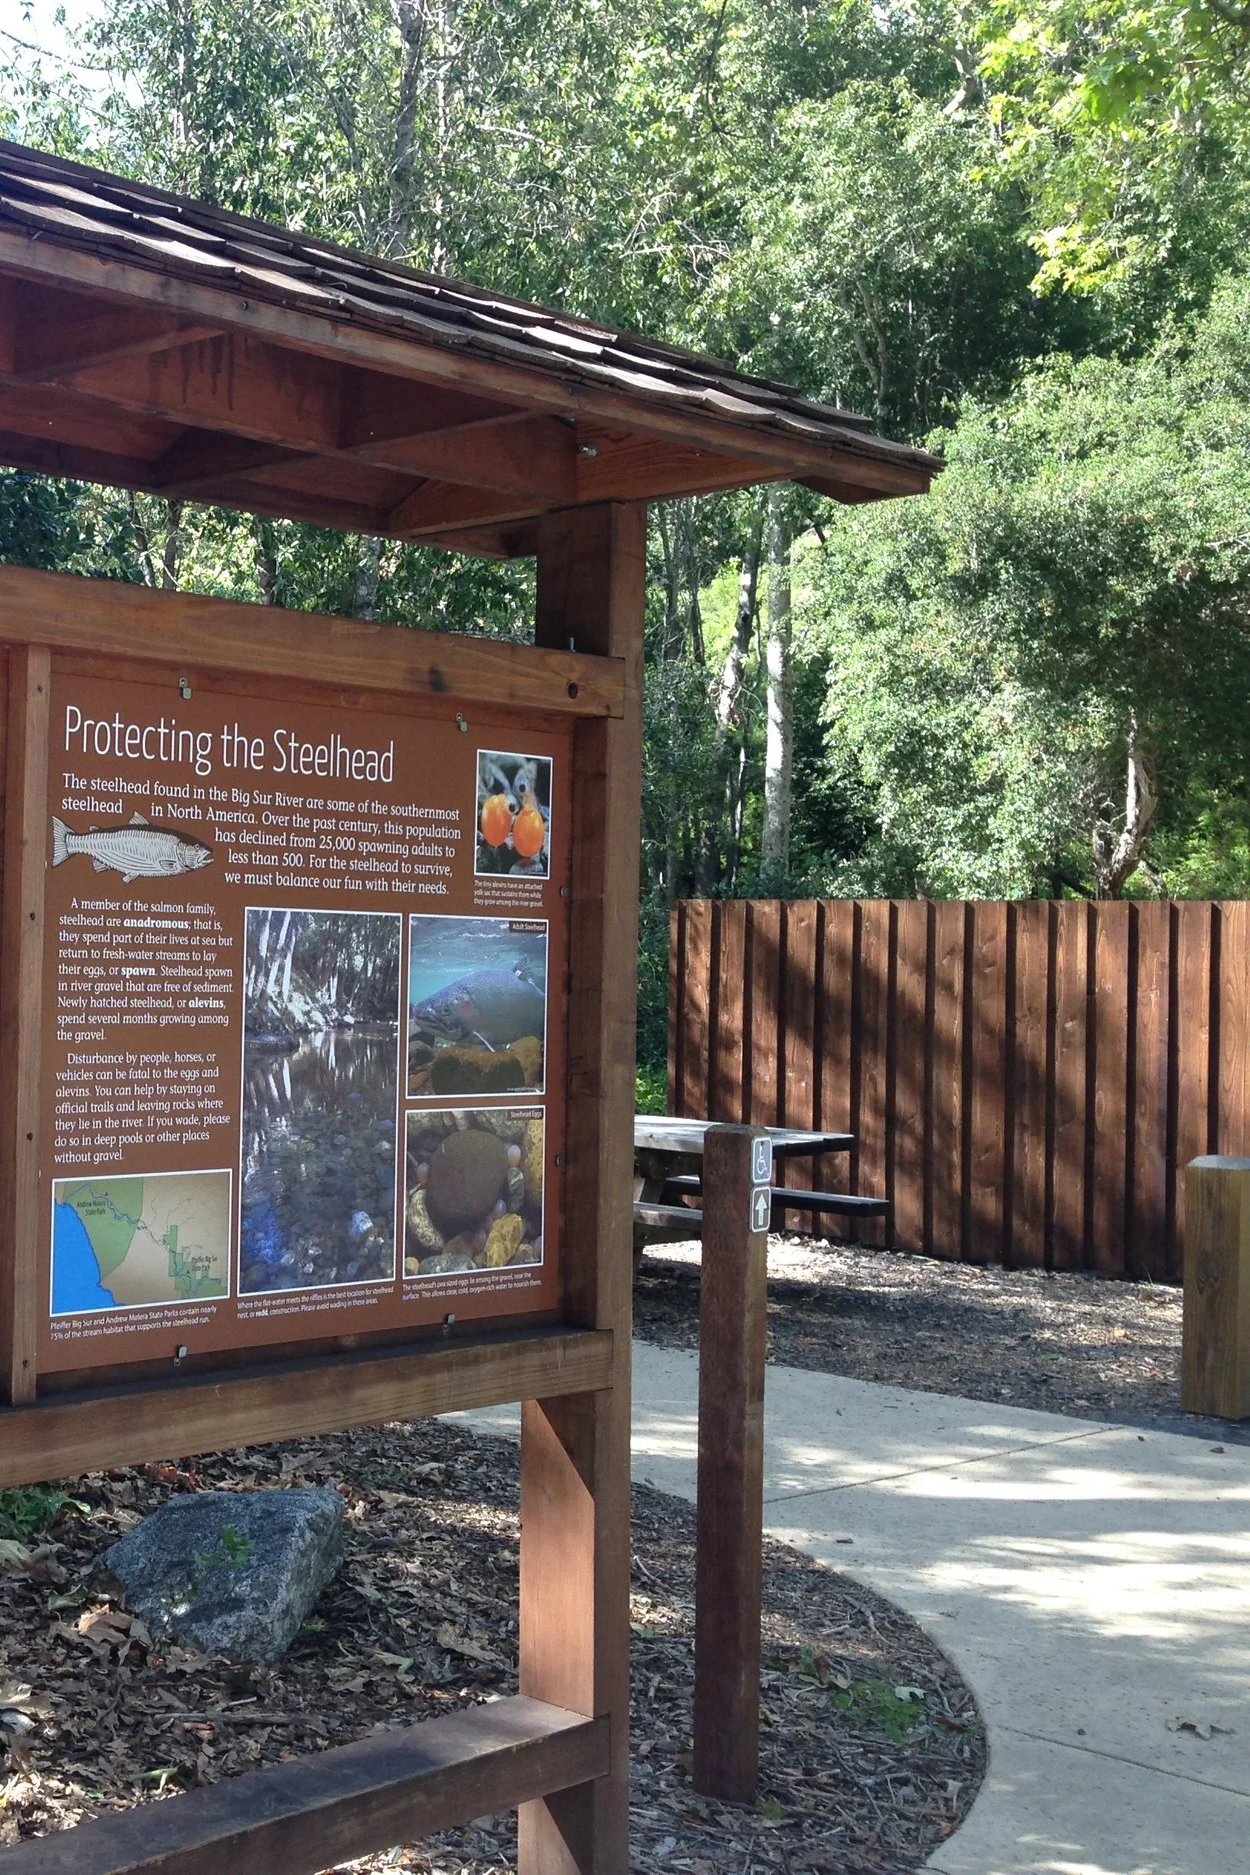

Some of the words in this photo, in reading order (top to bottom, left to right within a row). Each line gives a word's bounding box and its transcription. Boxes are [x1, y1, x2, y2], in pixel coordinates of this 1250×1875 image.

[65, 705, 212, 776] Protecting
[220, 722, 264, 770] the
[273, 729, 393, 783] Steelhead
[62, 773, 87, 790] The
[90, 777, 150, 795] steelhead
[153, 780, 190, 798] found
[193, 785, 205, 800] in
[209, 785, 228, 802] the
[231, 788, 250, 808] Big
[252, 790, 273, 805] Sur
[275, 792, 304, 808] River
[306, 798, 324, 810] are
[326, 799, 355, 812] some
[357, 799, 370, 813] of
[371, 800, 388, 815] the
[390, 803, 460, 821] southernmost
[215, 826, 236, 843] has
[239, 829, 287, 846] declined
[289, 832, 316, 848] from
[319, 835, 356, 852] 25,000
[358, 840, 409, 858] spawning
[411, 842, 443, 857] adults
[445, 845, 456, 858] to
[71, 897, 78, 909] A
[81, 898, 121, 911] member
[122, 899, 133, 911] of
[133, 900, 149, 912] the
[150, 901, 184, 913] salmon
[59, 913, 104, 926] steelhead
[106, 917, 122, 927] are
[193, 918, 212, 930] that
[67, 1052, 124, 1064] Disturbance
[126, 1051, 138, 1066] by
[206, 1053, 216, 1062] or
